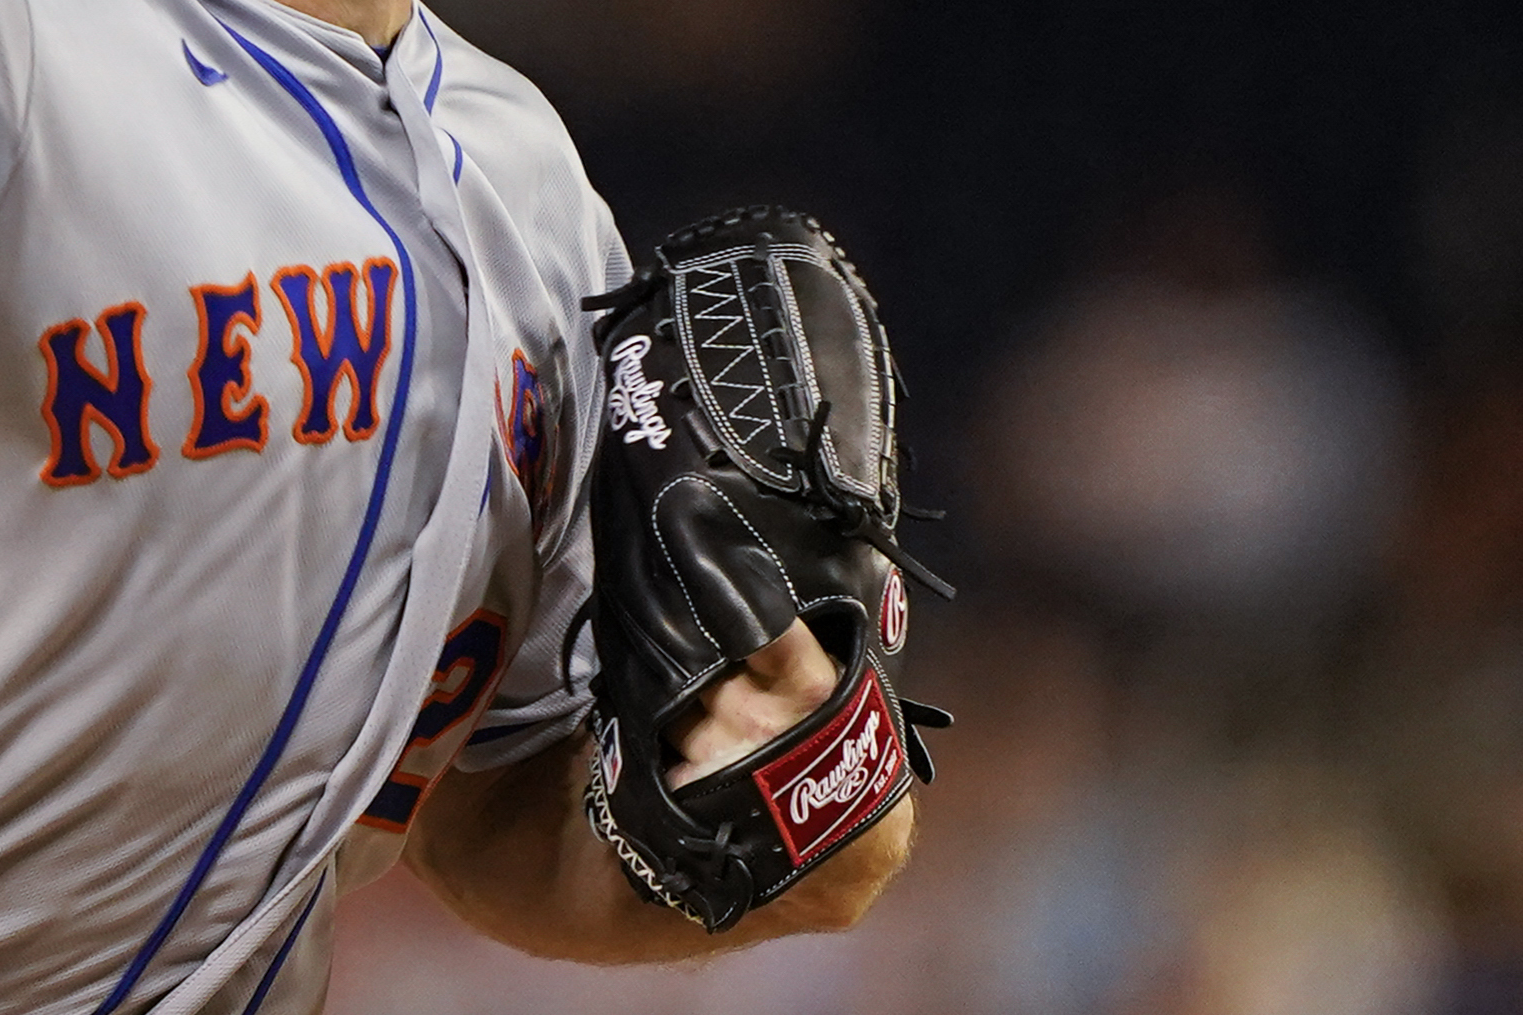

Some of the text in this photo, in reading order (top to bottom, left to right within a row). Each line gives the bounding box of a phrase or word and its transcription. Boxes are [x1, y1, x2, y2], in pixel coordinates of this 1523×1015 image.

[39, 256, 398, 488] NEW
[610, 334, 672, 450] Rawlings
[790, 710, 880, 825] Rawlings
